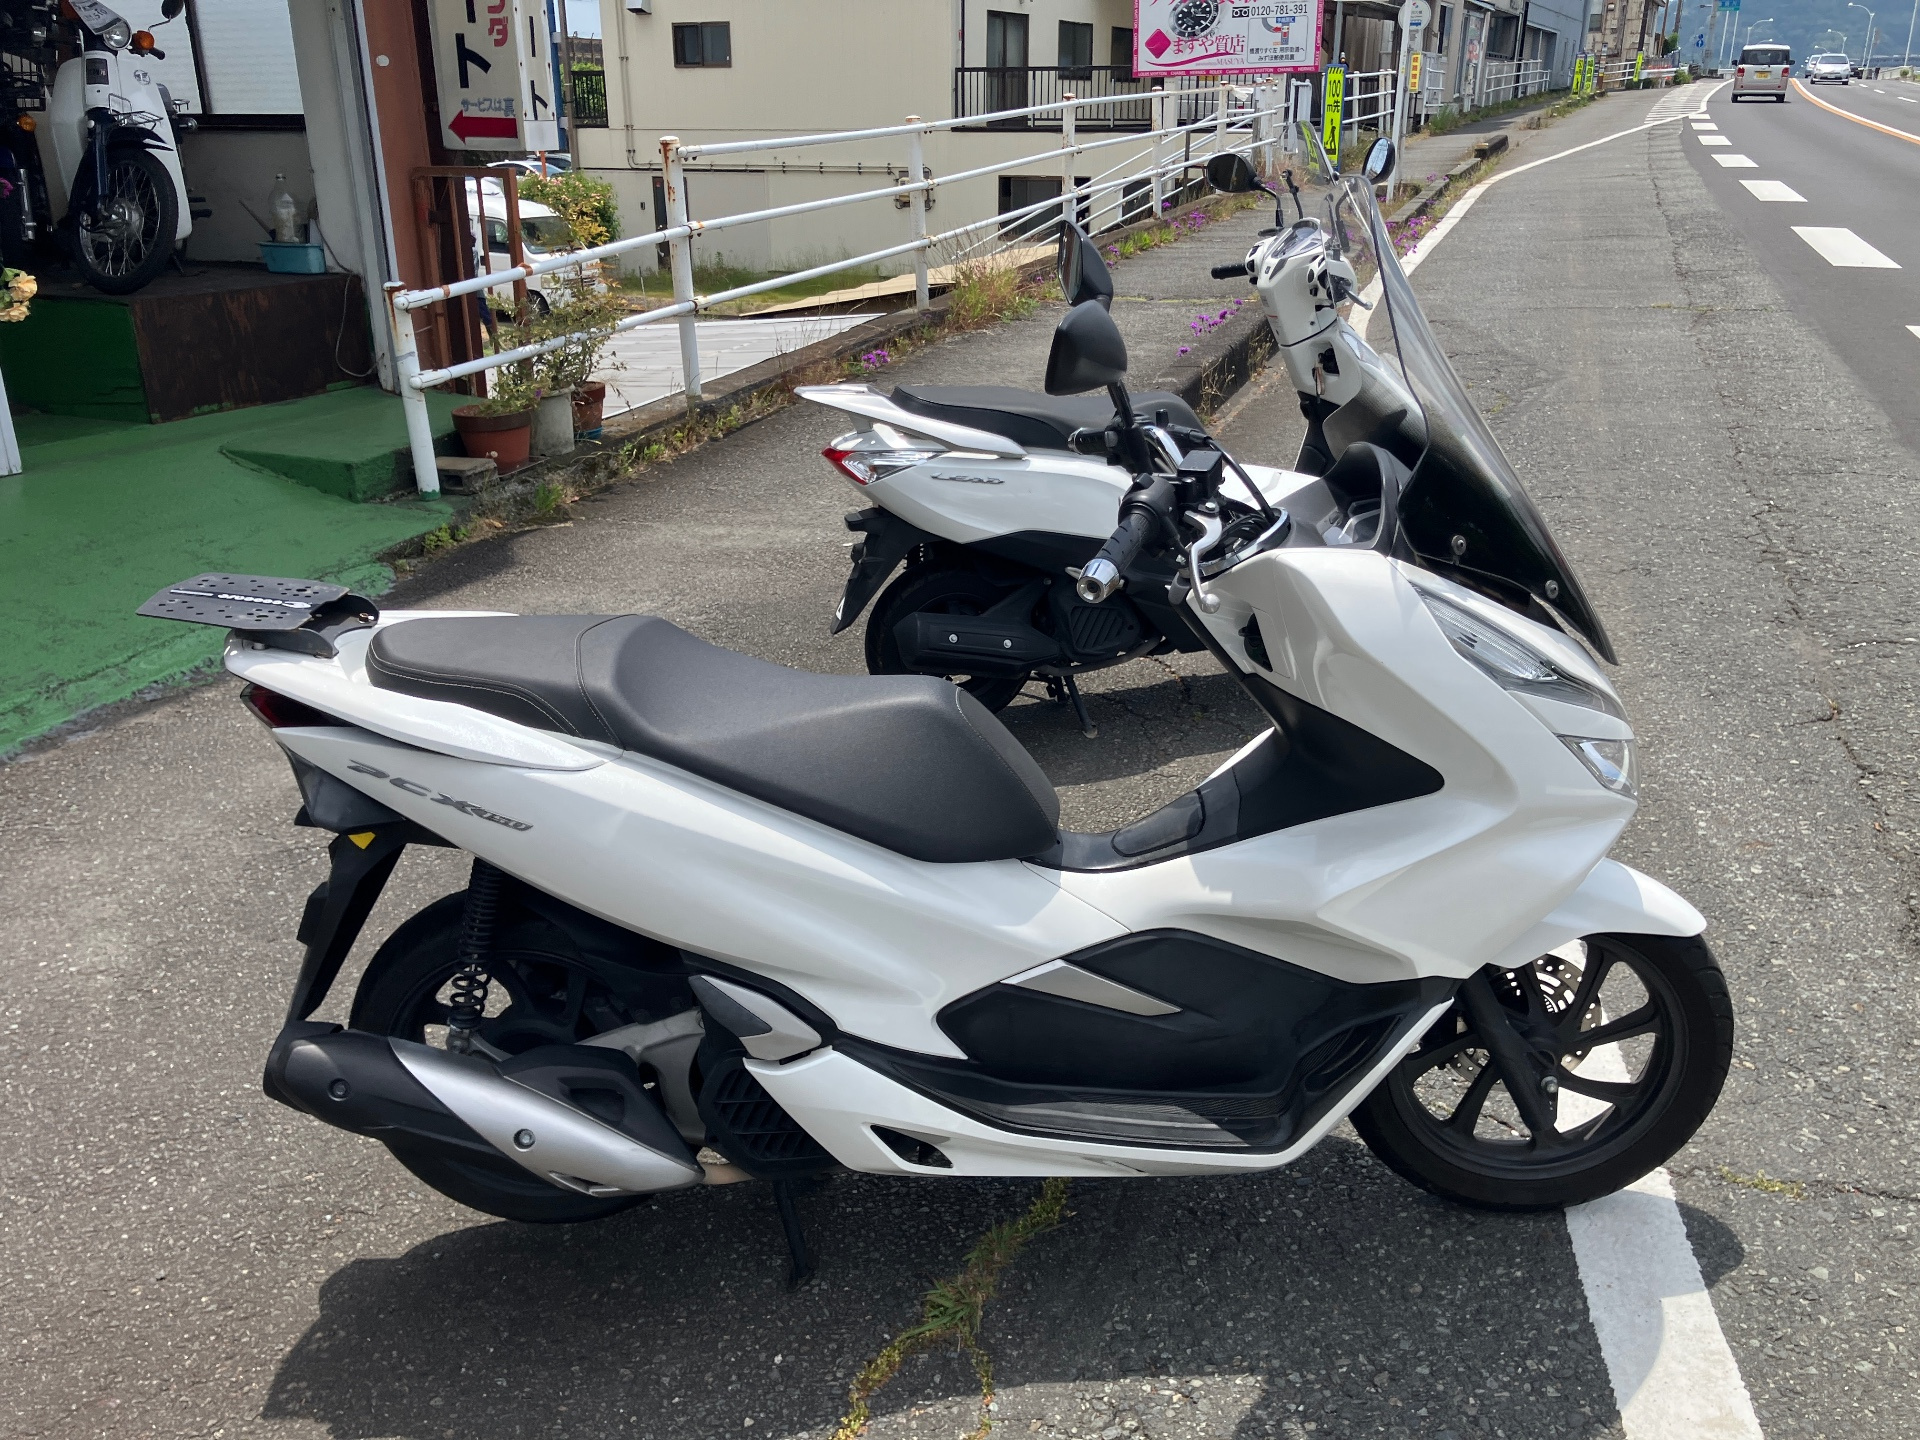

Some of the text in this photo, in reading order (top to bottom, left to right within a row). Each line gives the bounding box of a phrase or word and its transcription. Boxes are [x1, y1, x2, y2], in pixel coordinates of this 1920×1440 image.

[1251, 4, 1308, 16] 0120-781-391
[1173, 34, 1246, 55] ますや質店
[1328, 80, 1341, 97] 100
[1326, 99, 1341, 112] m先
[930, 472, 1005, 485] LEAD
[347, 759, 482, 816] PCX
